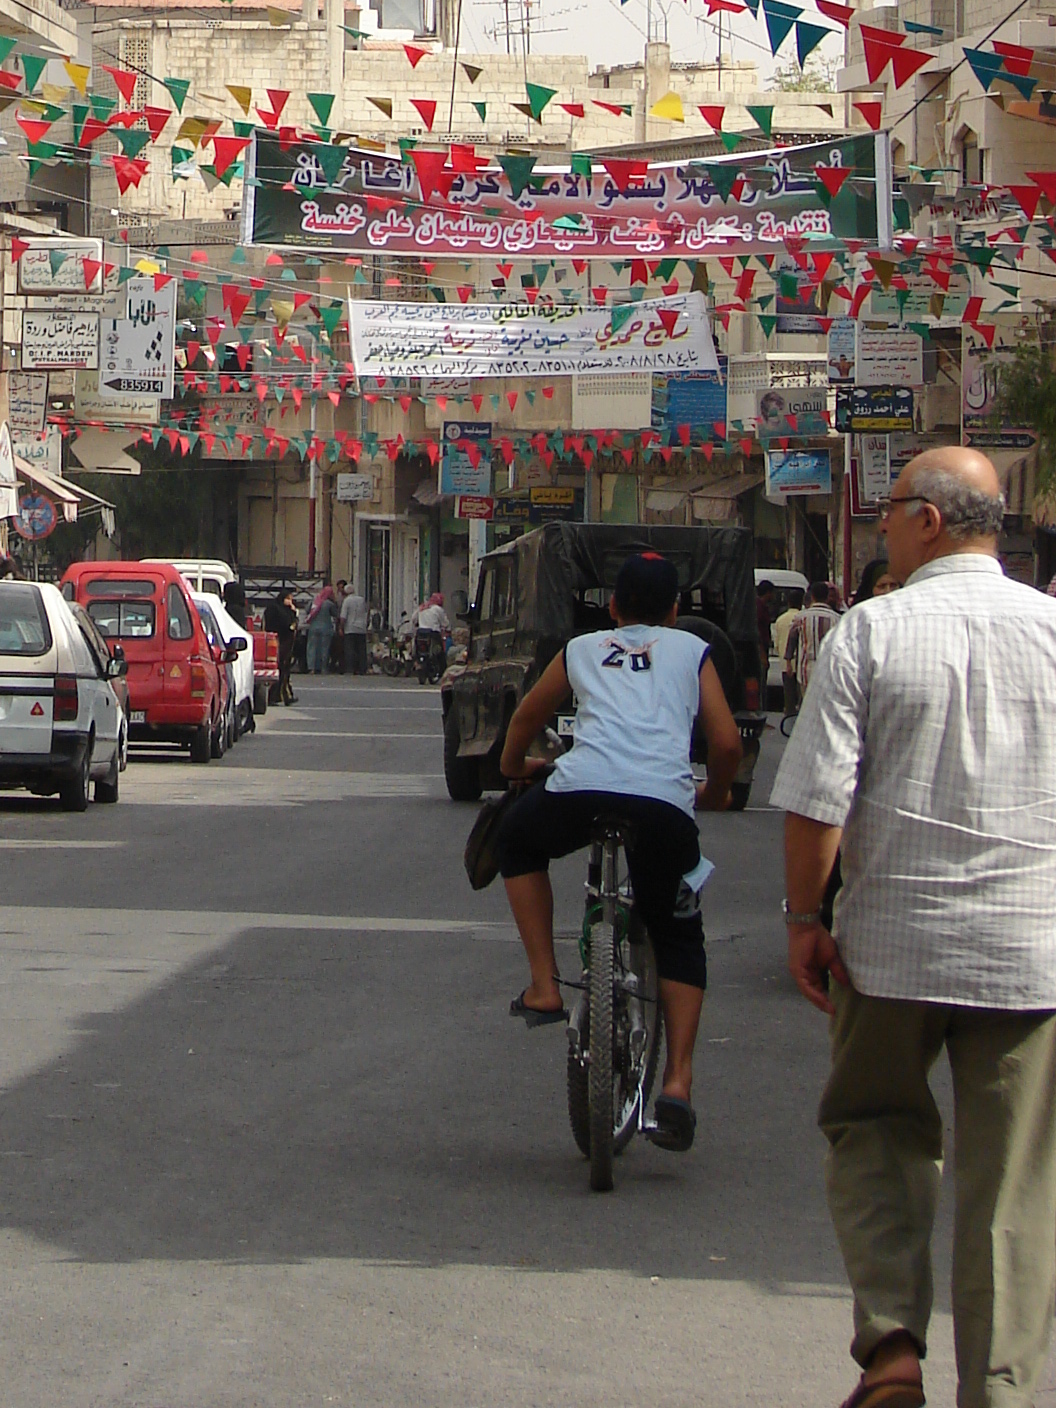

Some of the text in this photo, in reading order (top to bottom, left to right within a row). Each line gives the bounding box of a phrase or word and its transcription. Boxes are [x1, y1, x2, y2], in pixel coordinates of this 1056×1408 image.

[368, 208, 415, 246] علي
[120, 379, 163, 392] 835914
[894, 404, 910, 418] علي
